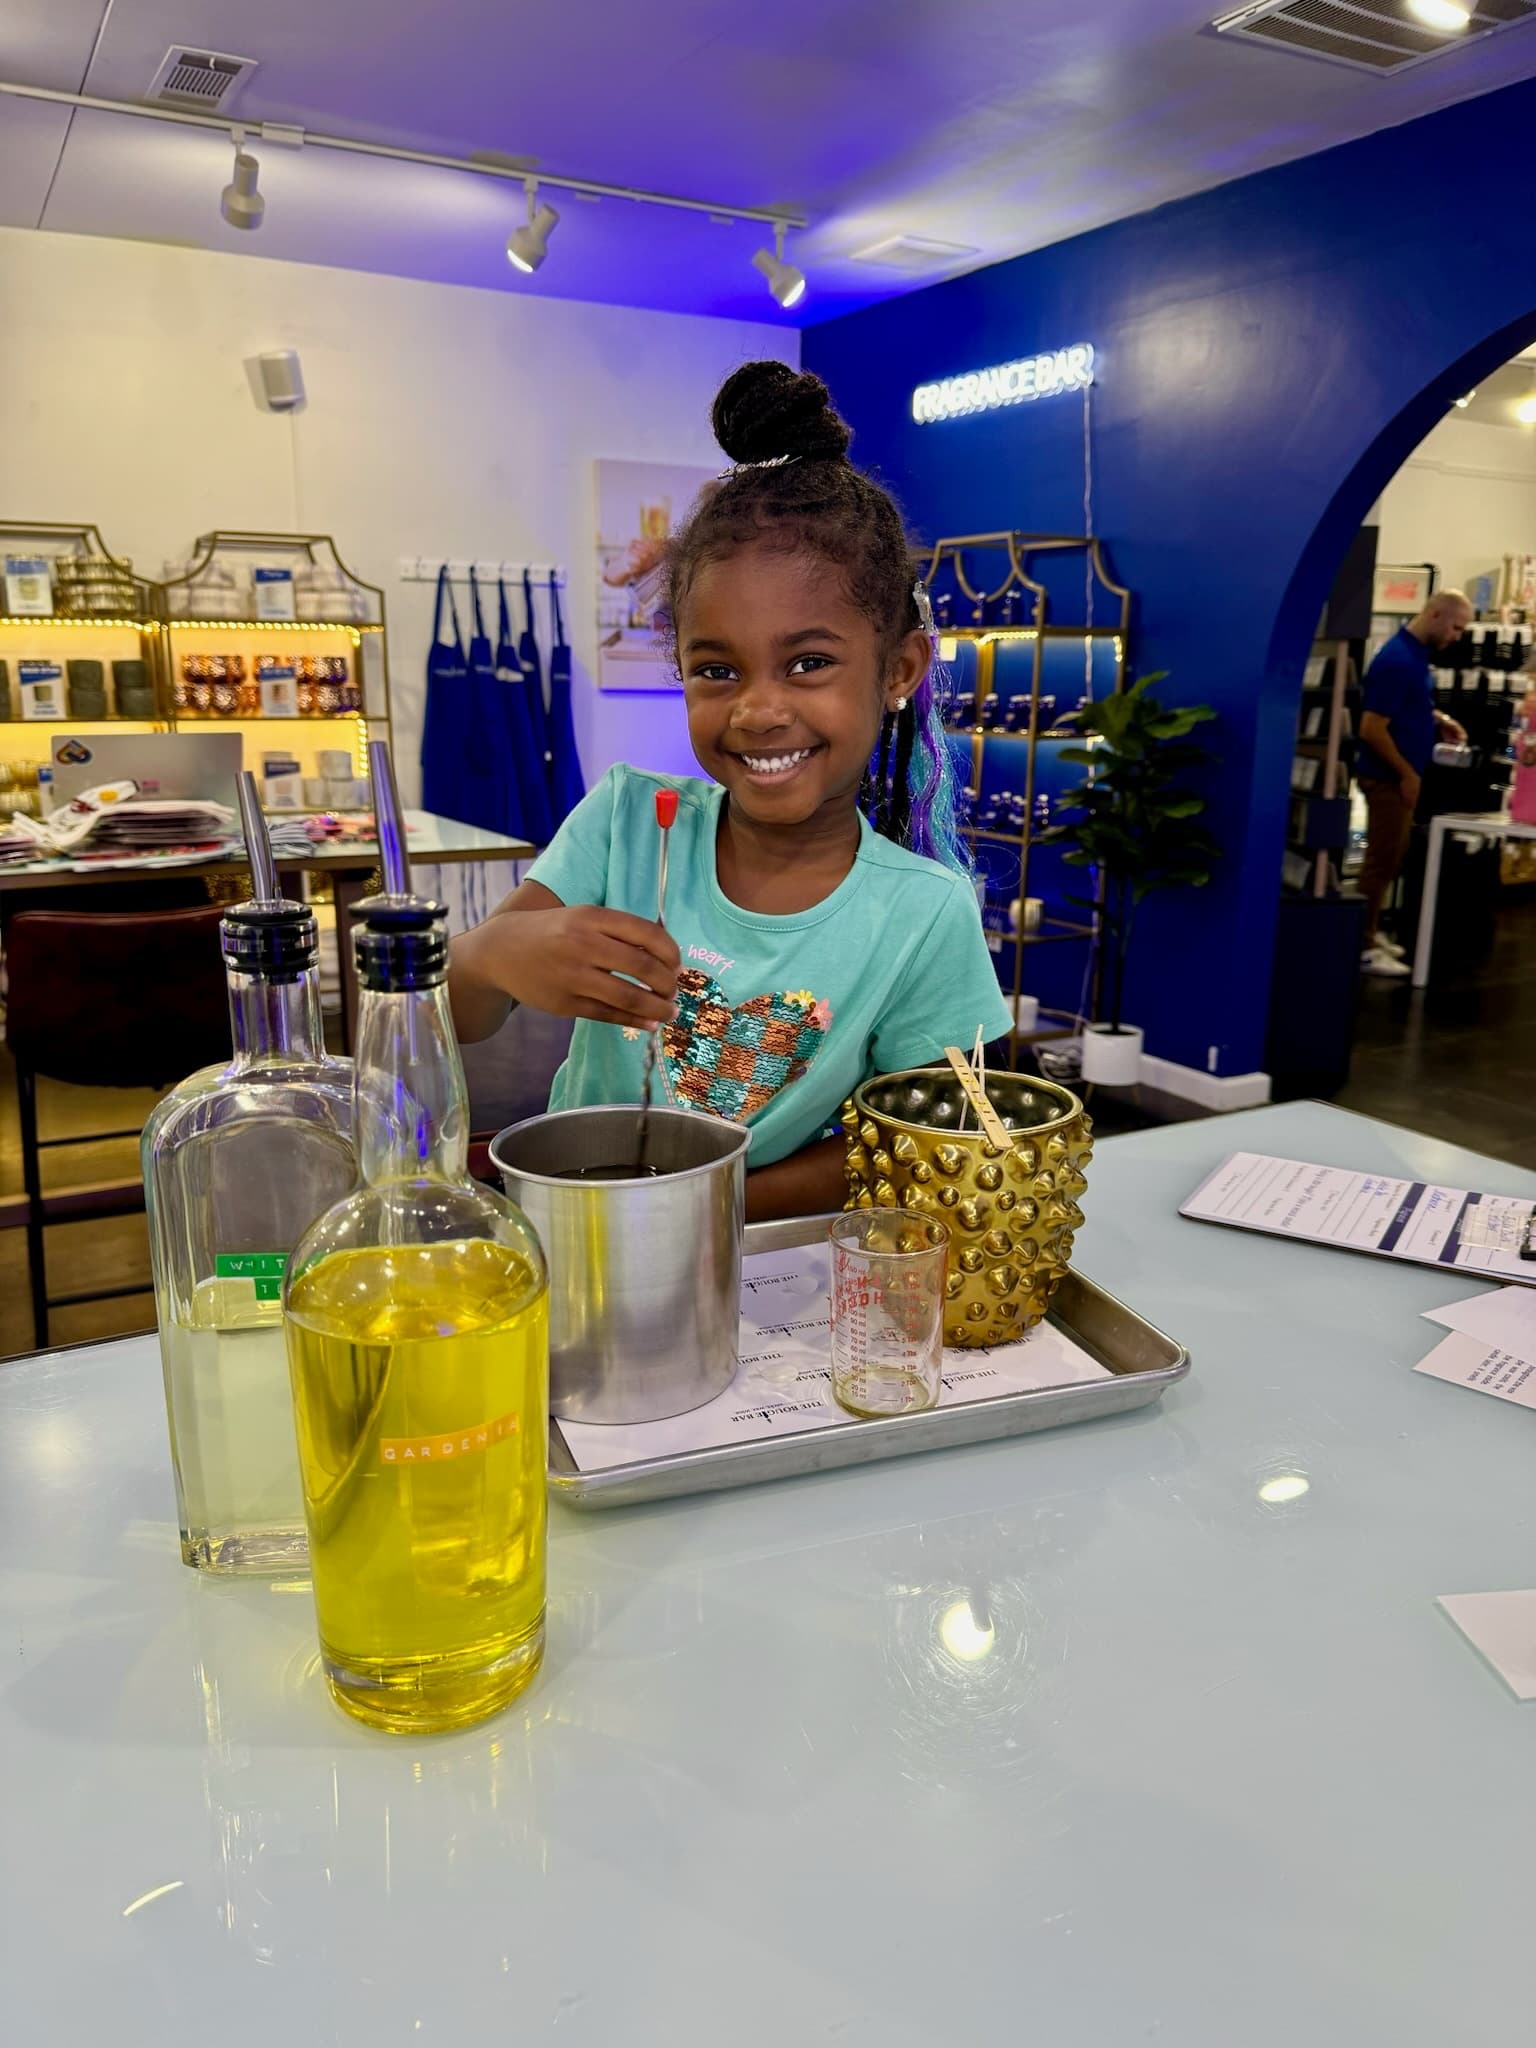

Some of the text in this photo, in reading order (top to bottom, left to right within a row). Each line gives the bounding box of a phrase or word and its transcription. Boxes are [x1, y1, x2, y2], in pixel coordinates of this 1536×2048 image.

[1035, 346, 1092, 395] BAR
[687, 944, 736, 976] heart
[229, 1258, 285, 1271] WHIT
[261, 1284, 281, 1295] TE
[816, 1319, 832, 1327] HE
[738, 1353, 784, 1366] THE BOU
[976, 1369, 1000, 1378] THE
[941, 1373, 976, 1391] BOUGI
[731, 1401, 824, 1424] THE BOUGIE BAR
[384, 1420, 518, 1461] GARDENIA
